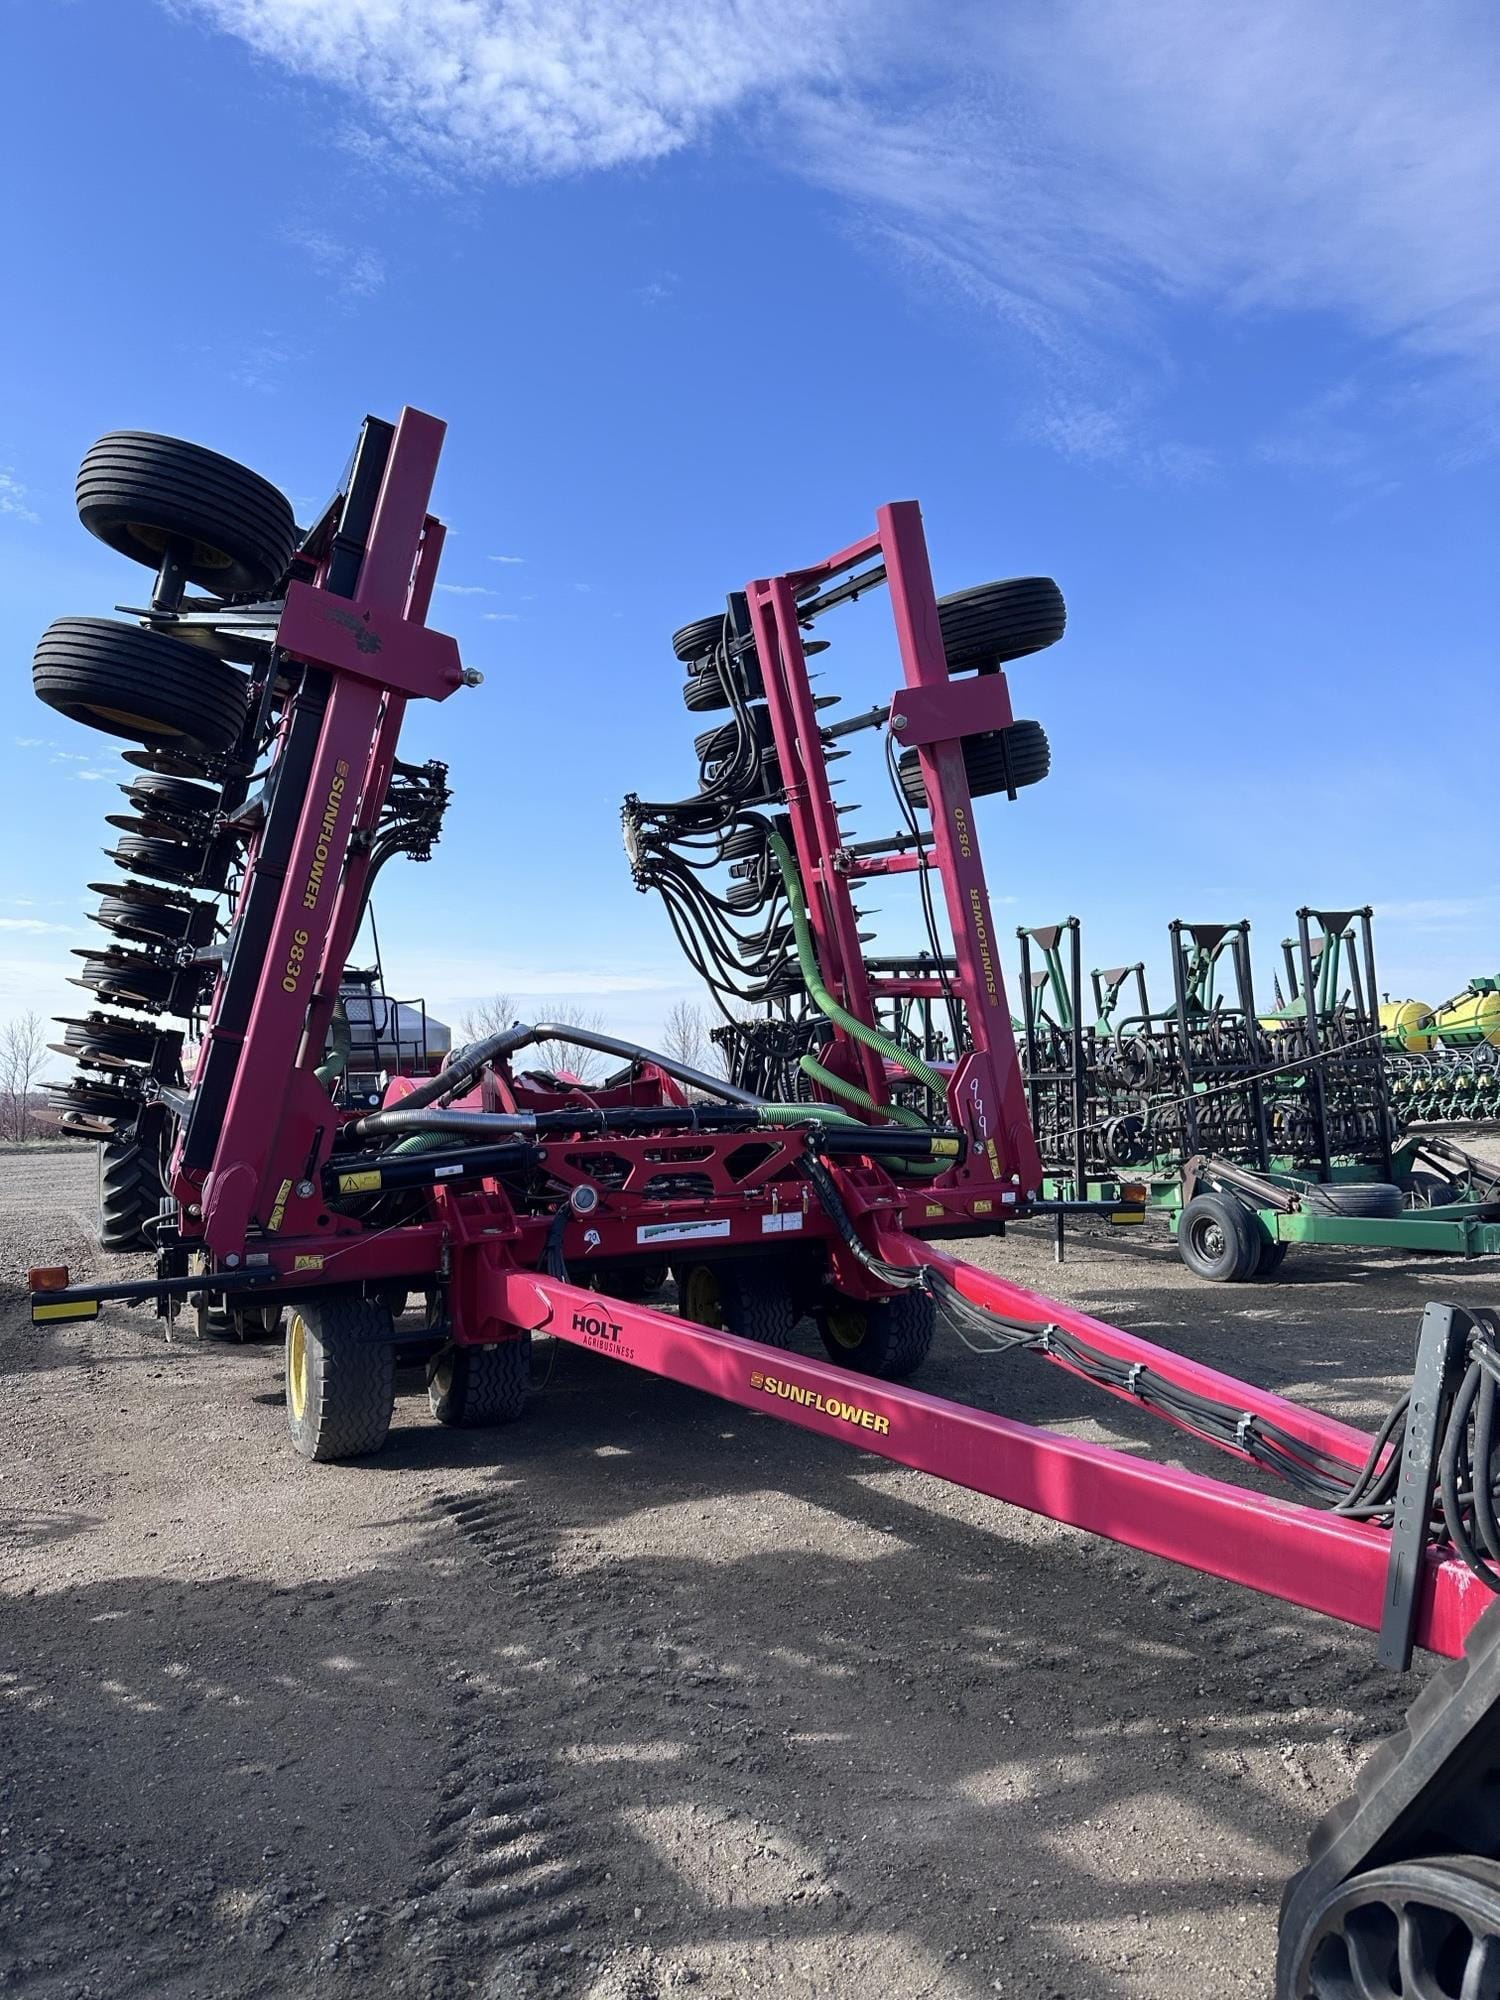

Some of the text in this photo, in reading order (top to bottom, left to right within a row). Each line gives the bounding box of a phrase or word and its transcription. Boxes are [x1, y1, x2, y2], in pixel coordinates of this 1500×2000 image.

[282, 776, 345, 993] SUNFLOWER 9830
[954, 807, 996, 992] SUNFLOWER 9830
[572, 1313, 623, 1343] HOLT
[583, 1335, 635, 1359] AGRIBUSINESS
[764, 1376, 890, 1434] SUNFLOWER
